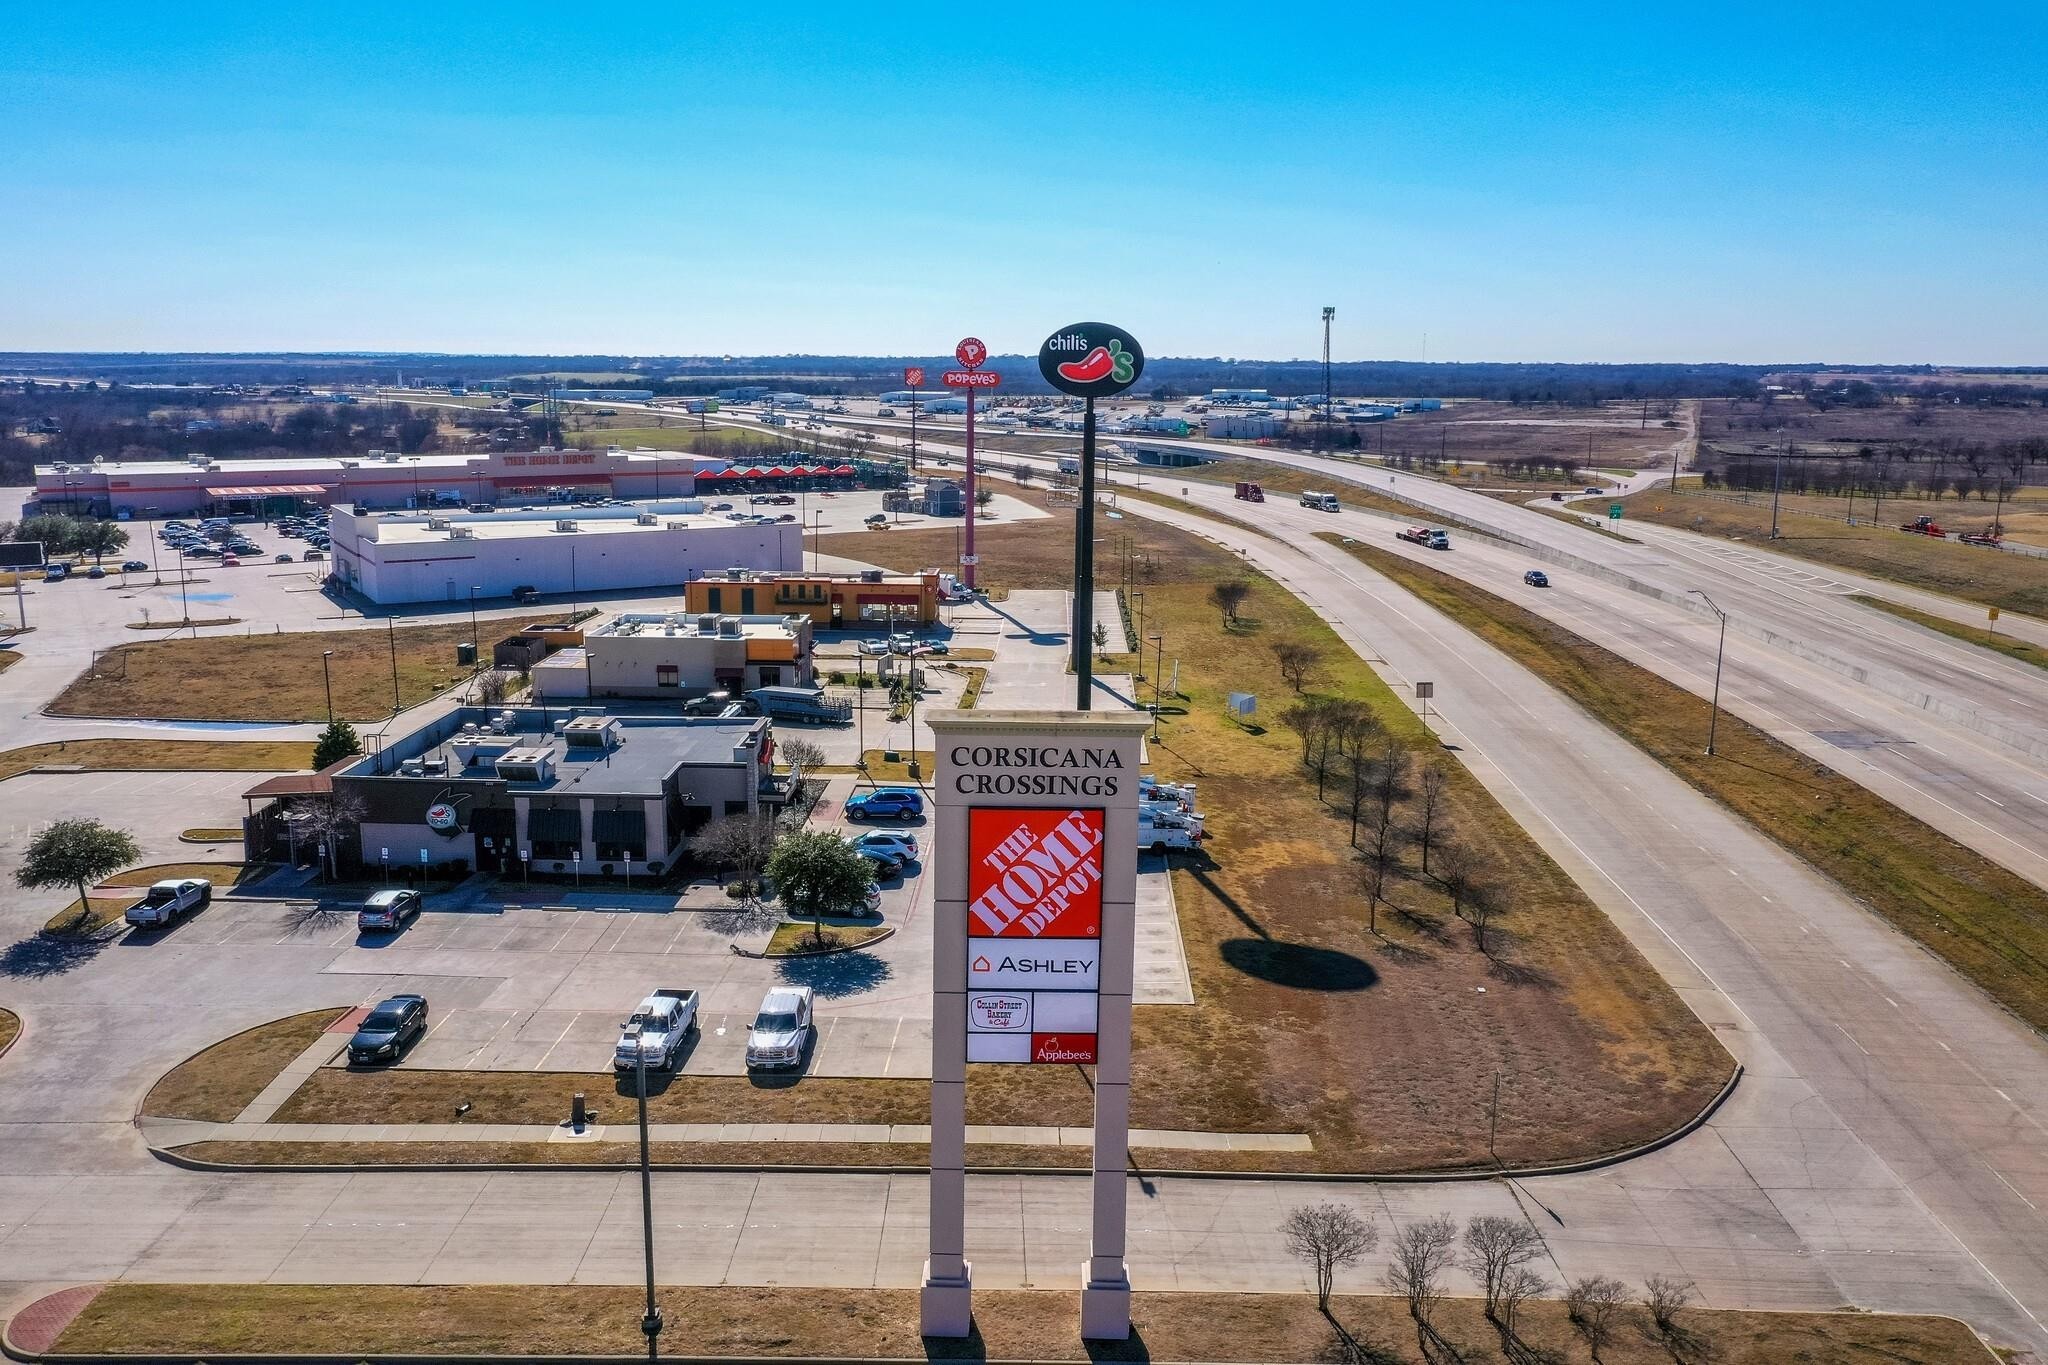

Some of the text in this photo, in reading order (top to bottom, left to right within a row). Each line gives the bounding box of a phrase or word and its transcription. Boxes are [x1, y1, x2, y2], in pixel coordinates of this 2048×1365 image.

[950, 746, 1124, 769] CORSICANA
[955, 774, 1118, 796] CROSSINGS
[982, 823, 1039, 873] THE
[969, 809, 1103, 937] HOME
[1018, 855, 1102, 937] DEPOT
[997, 956, 1093, 973] ASHLEY
[1037, 1048, 1092, 1062] Applebee's
